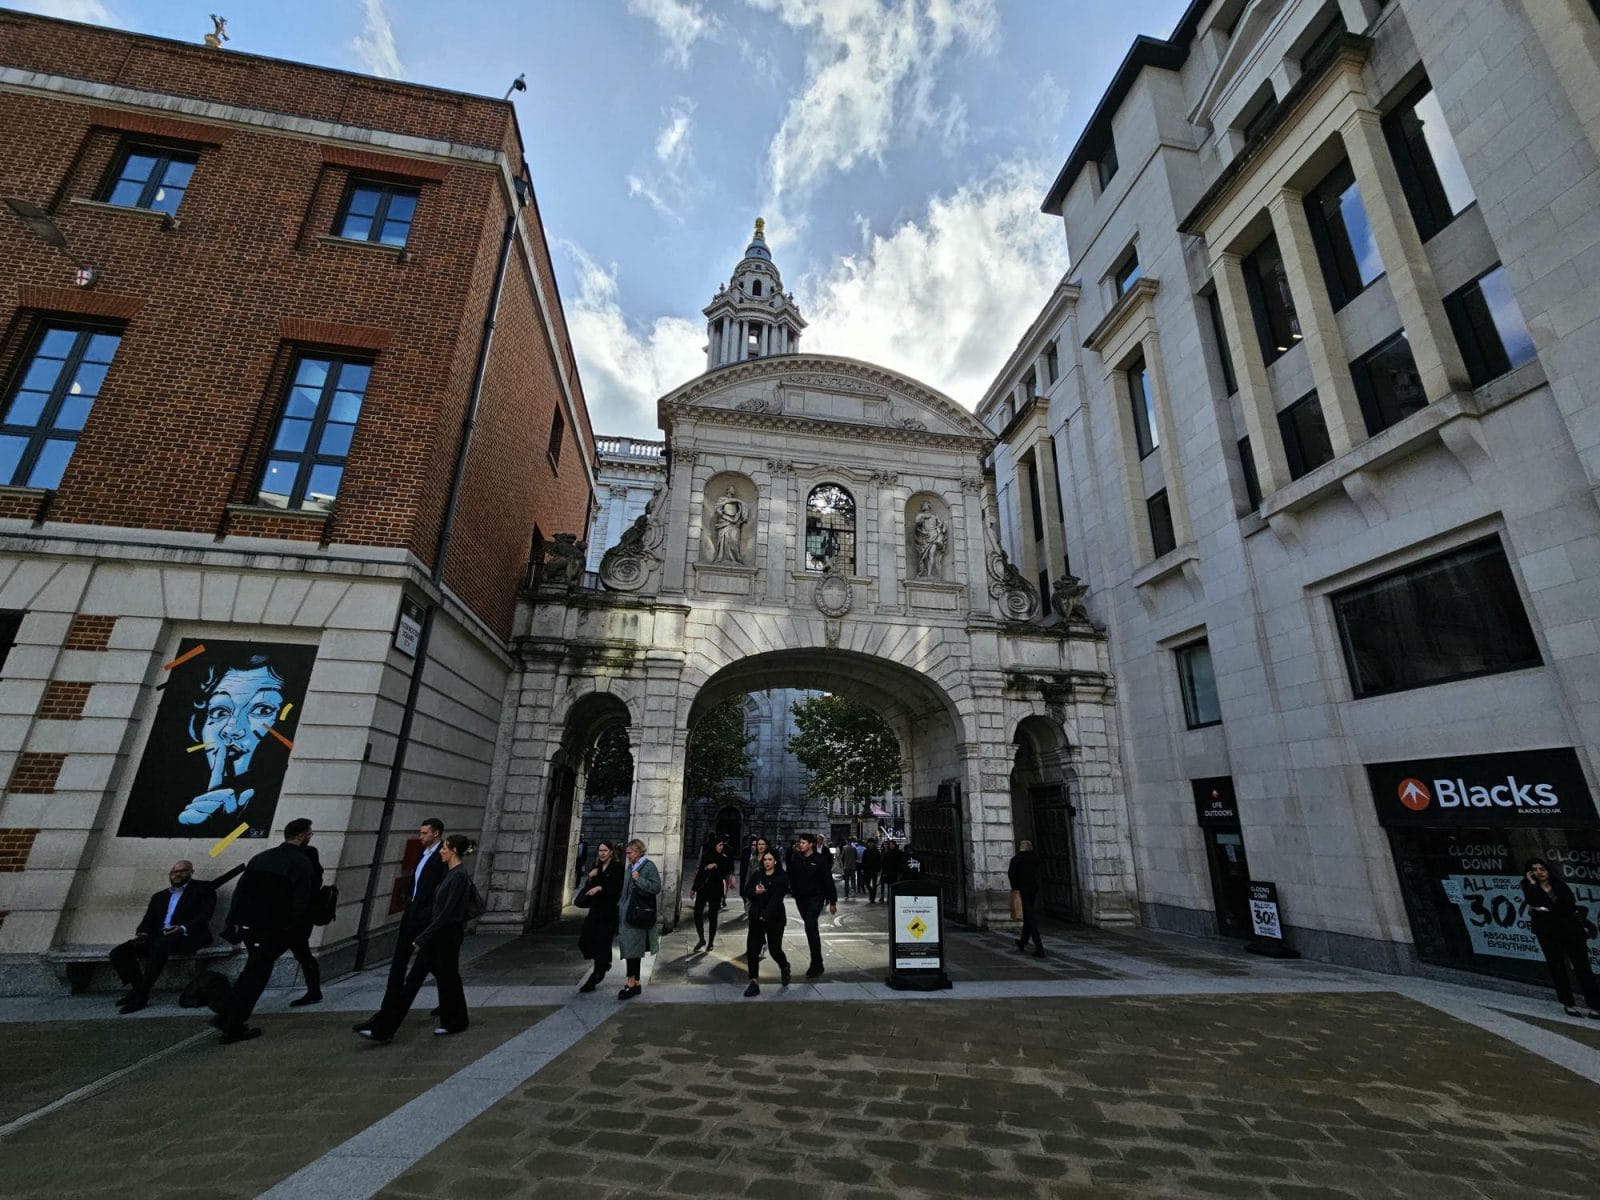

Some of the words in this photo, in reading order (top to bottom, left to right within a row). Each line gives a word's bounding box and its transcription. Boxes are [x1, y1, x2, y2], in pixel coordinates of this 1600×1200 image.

[1433, 776, 1559, 808] Blacks
[1204, 809, 1233, 817] OUTDOORS
[1448, 844, 1508, 857] CLOSING
[1461, 858, 1503, 871] DOWN
[1250, 886, 1270, 894] CLOSING
[1463, 877, 1494, 892] ALL
[1254, 910, 1277, 925] 30%
[1484, 931, 1537, 943] ABSOLUTELY
[1488, 941, 1539, 953] EVERYTHING
